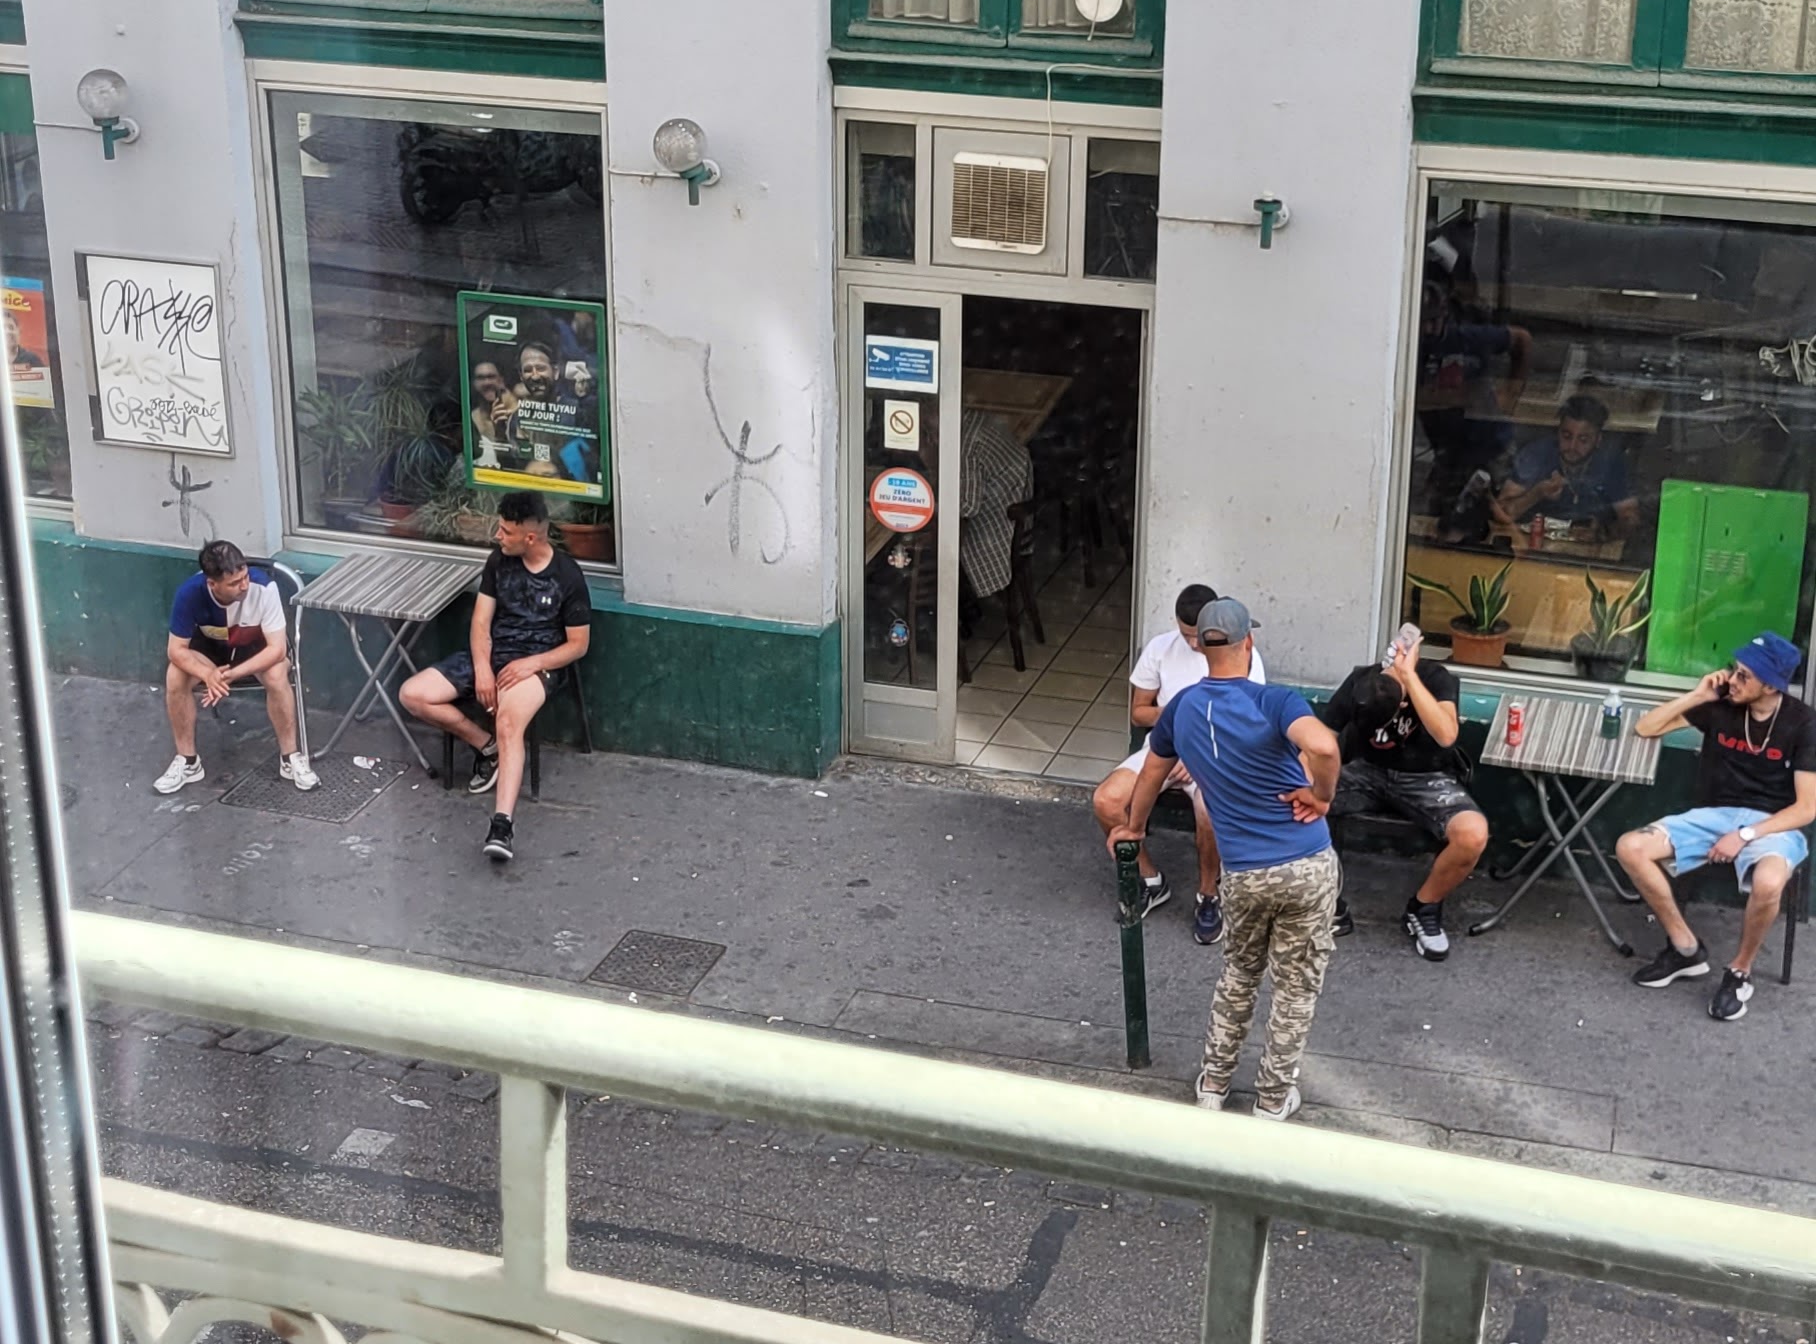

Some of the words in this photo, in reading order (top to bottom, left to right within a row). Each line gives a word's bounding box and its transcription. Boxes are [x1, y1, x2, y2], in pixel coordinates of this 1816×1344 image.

[517, 399, 546, 411] NOTRE
[548, 403, 577, 415] TUYAU
[518, 409, 531, 418] DU
[532, 411, 555, 421] JOUR
